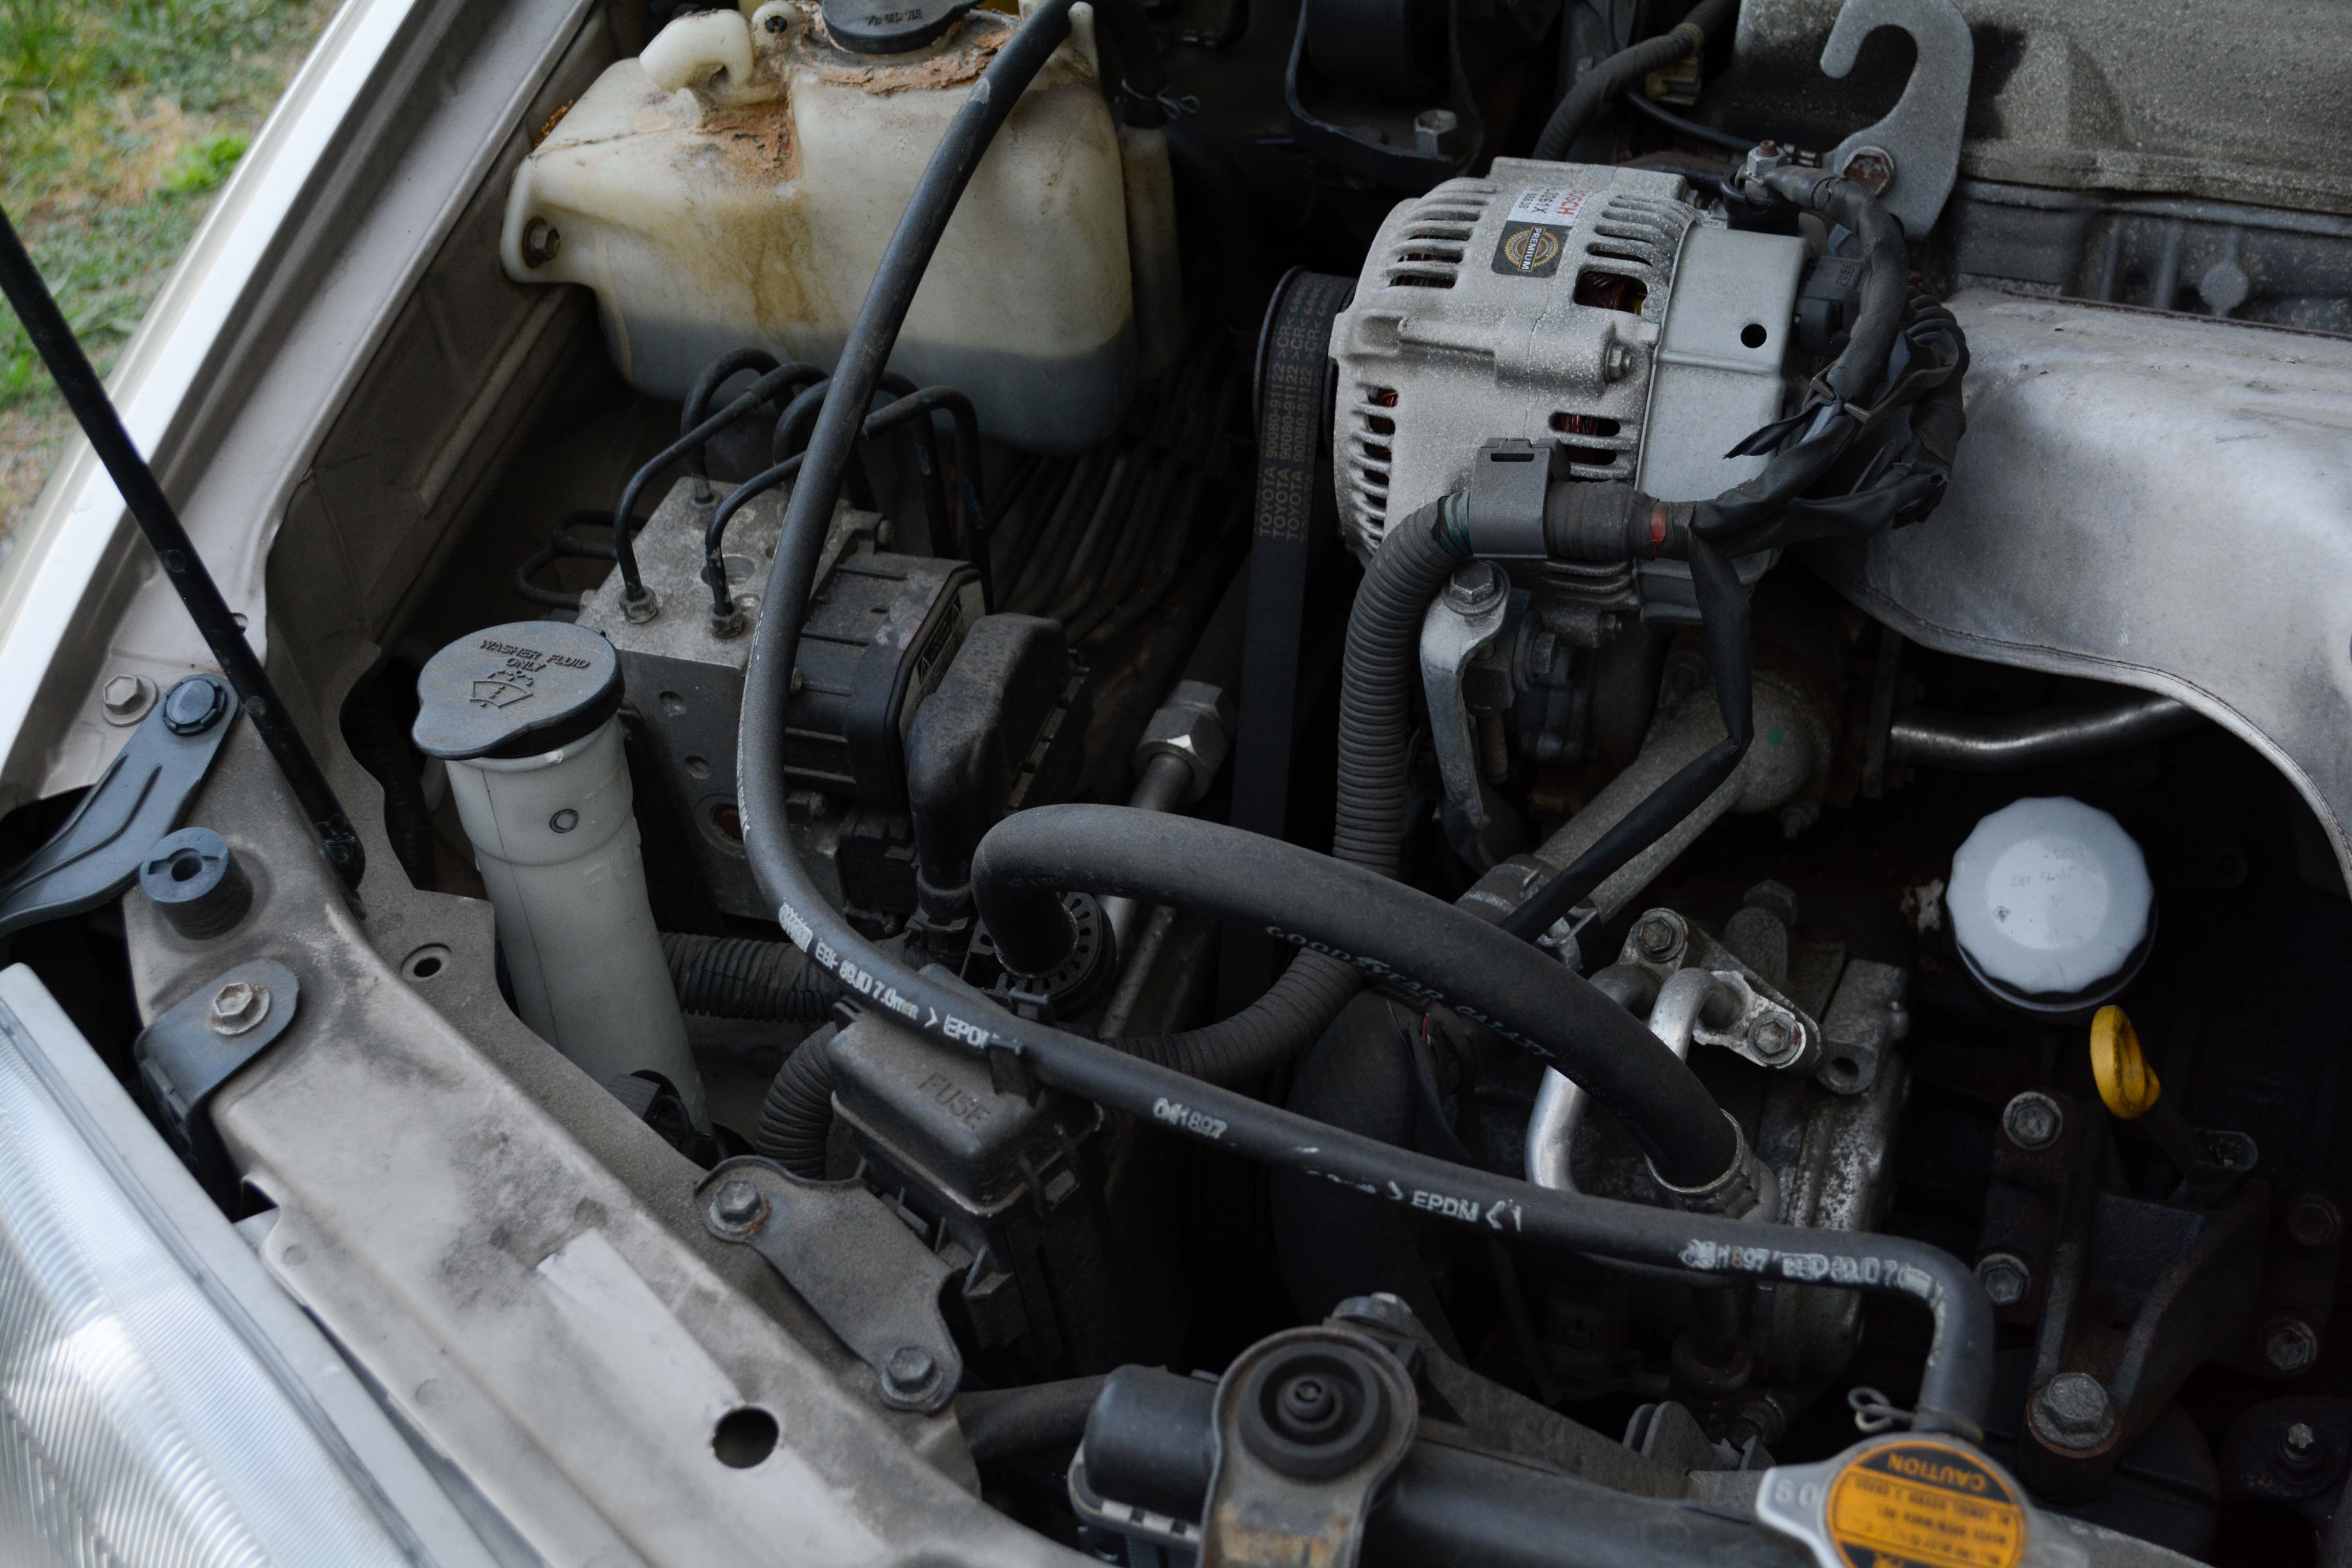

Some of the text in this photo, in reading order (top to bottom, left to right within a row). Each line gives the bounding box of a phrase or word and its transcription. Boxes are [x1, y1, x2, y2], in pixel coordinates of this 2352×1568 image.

[1521, 228, 1542, 270] PREMIUM
[1266, 362, 1285, 458] 90080-91122
[1279, 365, 1299, 460] 90080-91122
[1293, 367, 1313, 463] 90080-91122
[1259, 467, 1276, 537] TOYOTA
[1273, 469, 1290, 538] TOYOTA
[1286, 470, 1304, 541] TOYOTA
[479, 639, 590, 669] WASHER FLUID
[506, 657, 547, 673] ONLY
[1265, 926, 1557, 1059] GOODYEAR GALAXY
[918, 1072, 991, 1130] FUSE
[1410, 1189, 1479, 1223] EPDM
[1887, 1451, 1988, 1493] CAUTION
